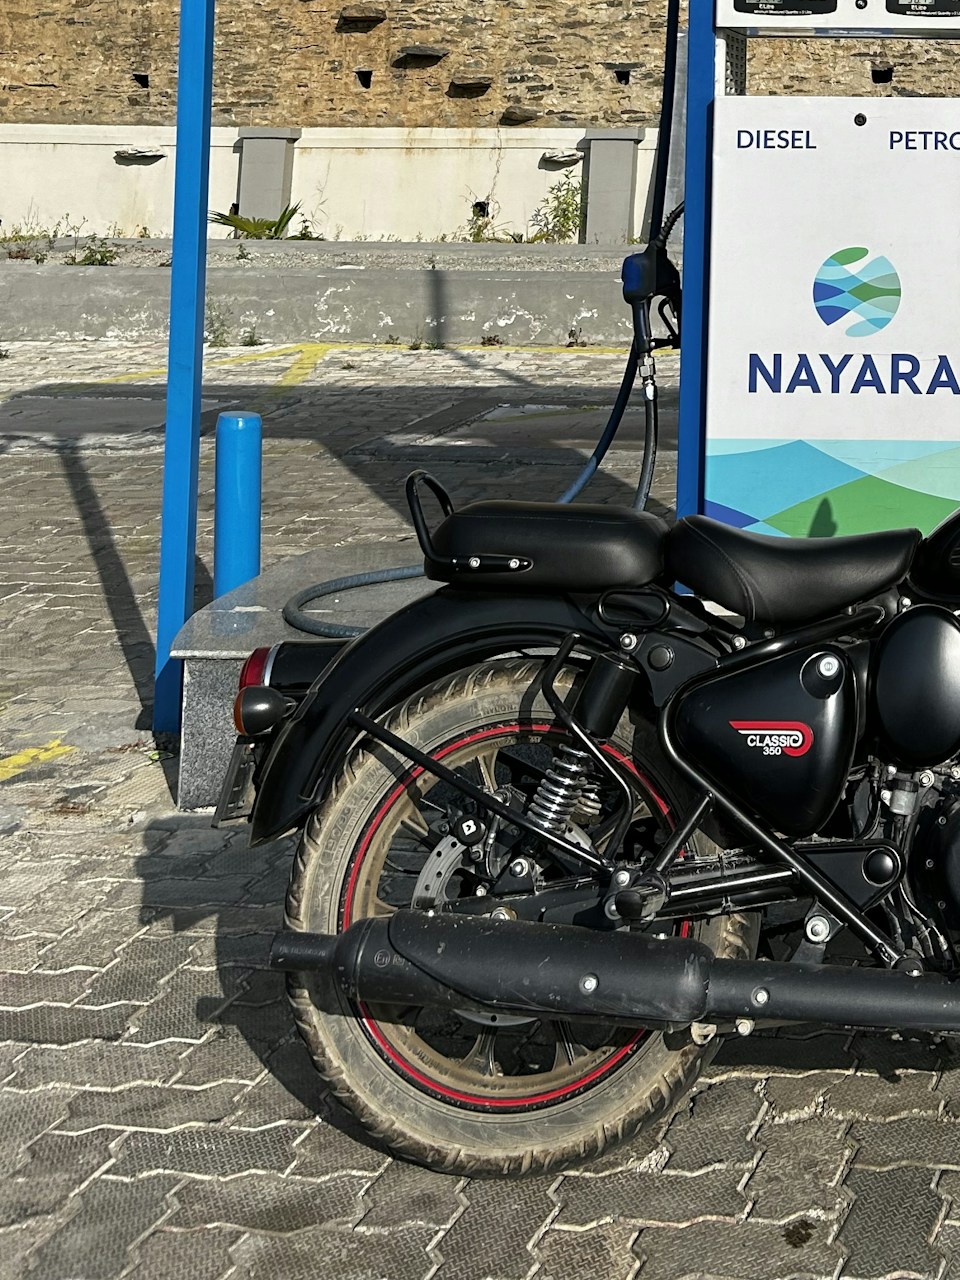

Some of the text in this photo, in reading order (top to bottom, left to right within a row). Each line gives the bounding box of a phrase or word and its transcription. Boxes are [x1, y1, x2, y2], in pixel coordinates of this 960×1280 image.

[736, 130, 817, 149] DIESEL
[747, 735, 803, 747] CLASSIC
[763, 747, 782, 755] 350
